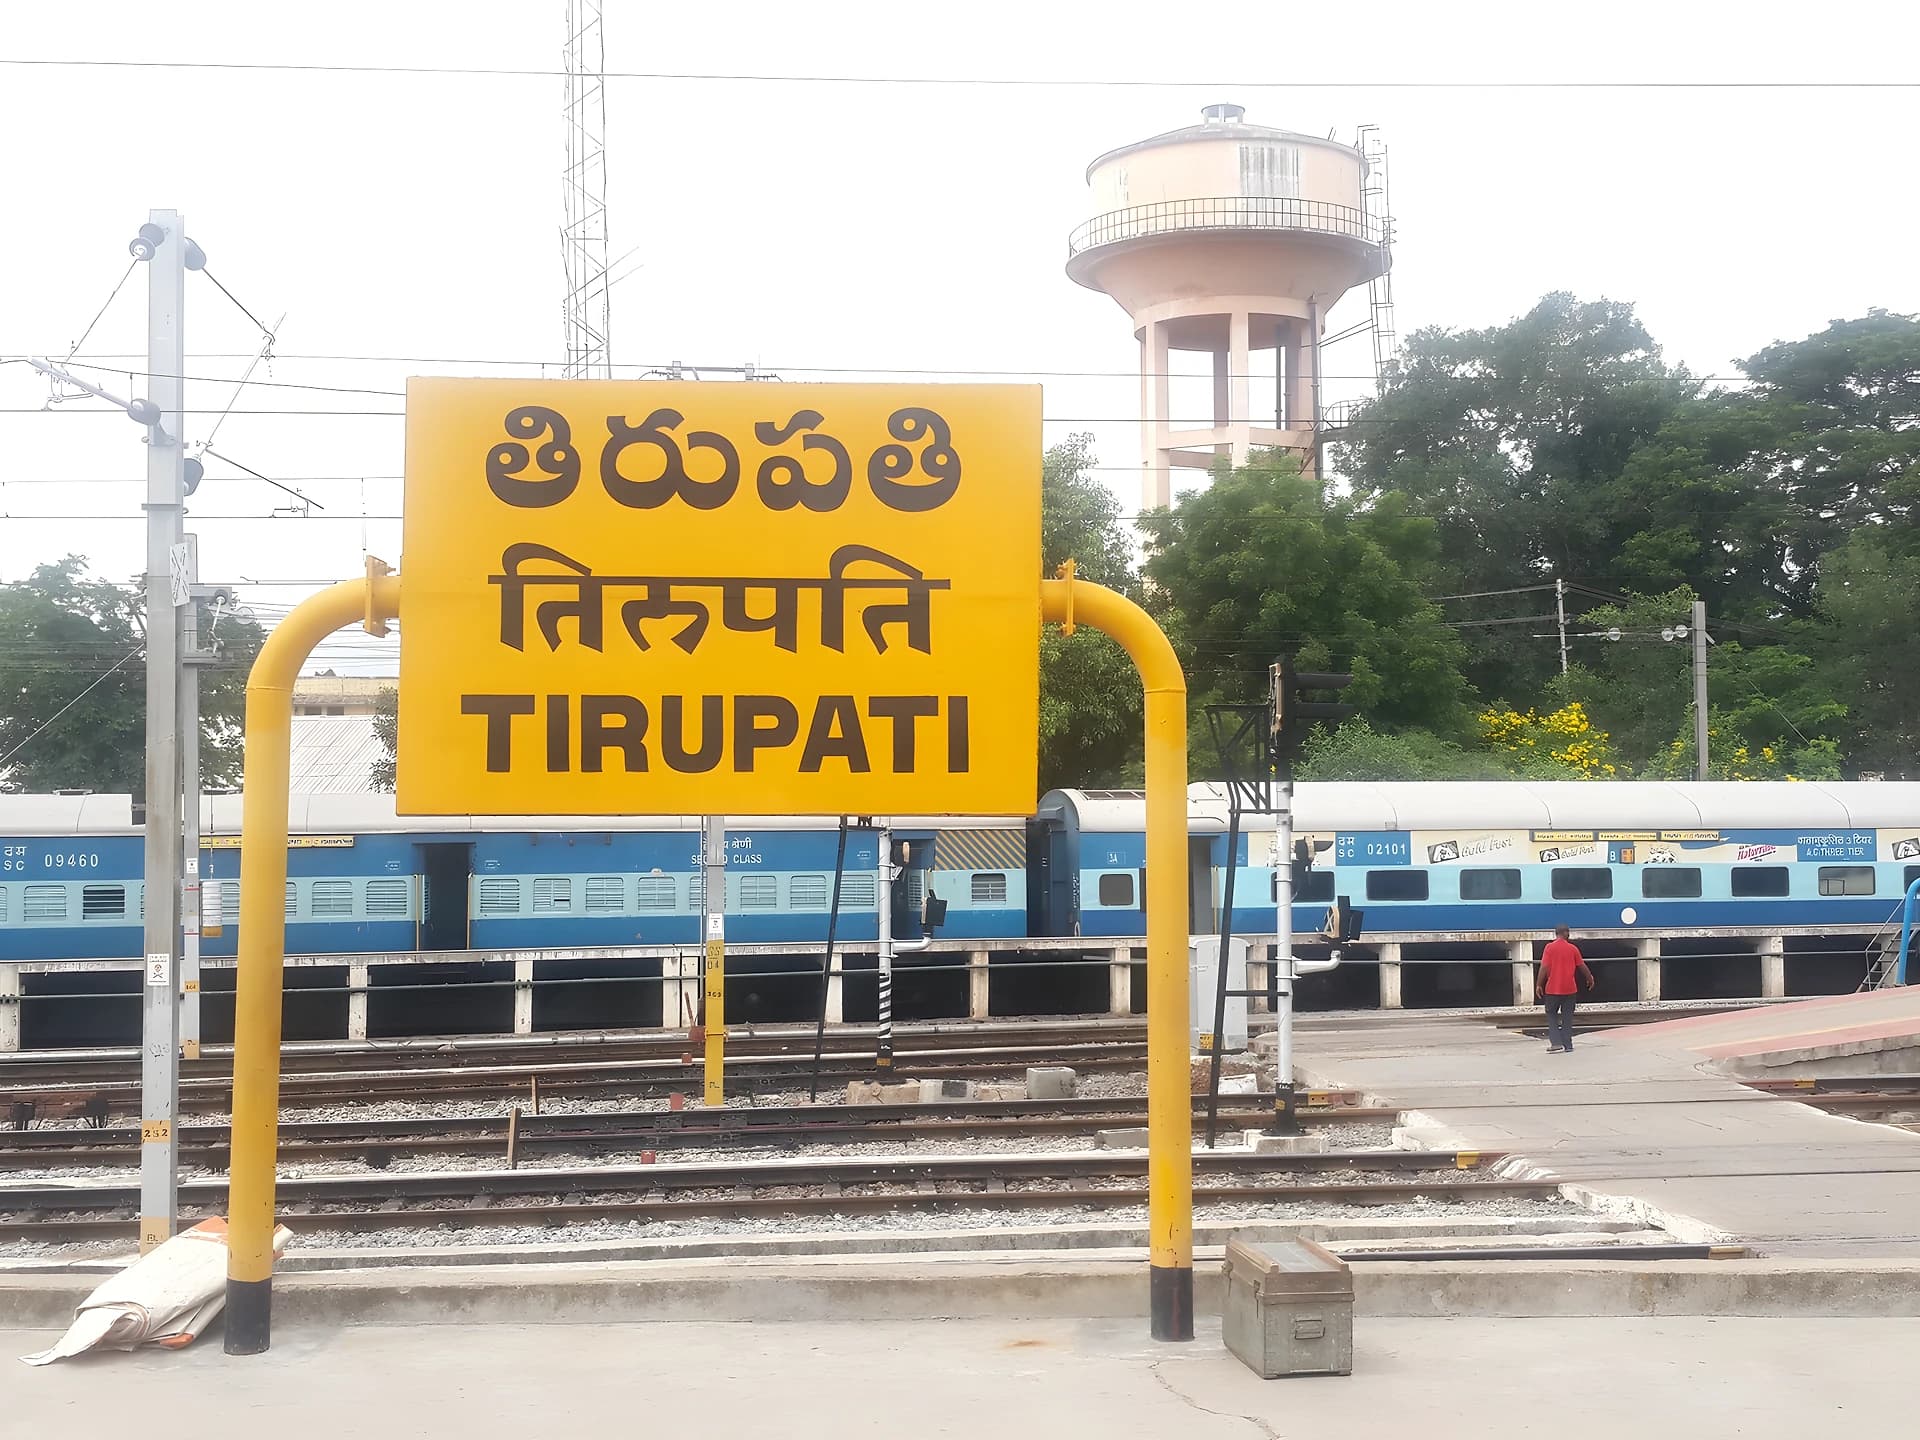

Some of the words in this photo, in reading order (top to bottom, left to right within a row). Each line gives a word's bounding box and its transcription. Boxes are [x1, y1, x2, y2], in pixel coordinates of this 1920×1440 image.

[486, 406, 961, 512] తిరుపతి
[488, 543, 950, 655] तिरुपति
[461, 695, 968, 773] TIRUPATI
[44, 854, 99, 868] 09460
[733, 854, 762, 864] CLASS
[1367, 843, 1406, 855] 02101
